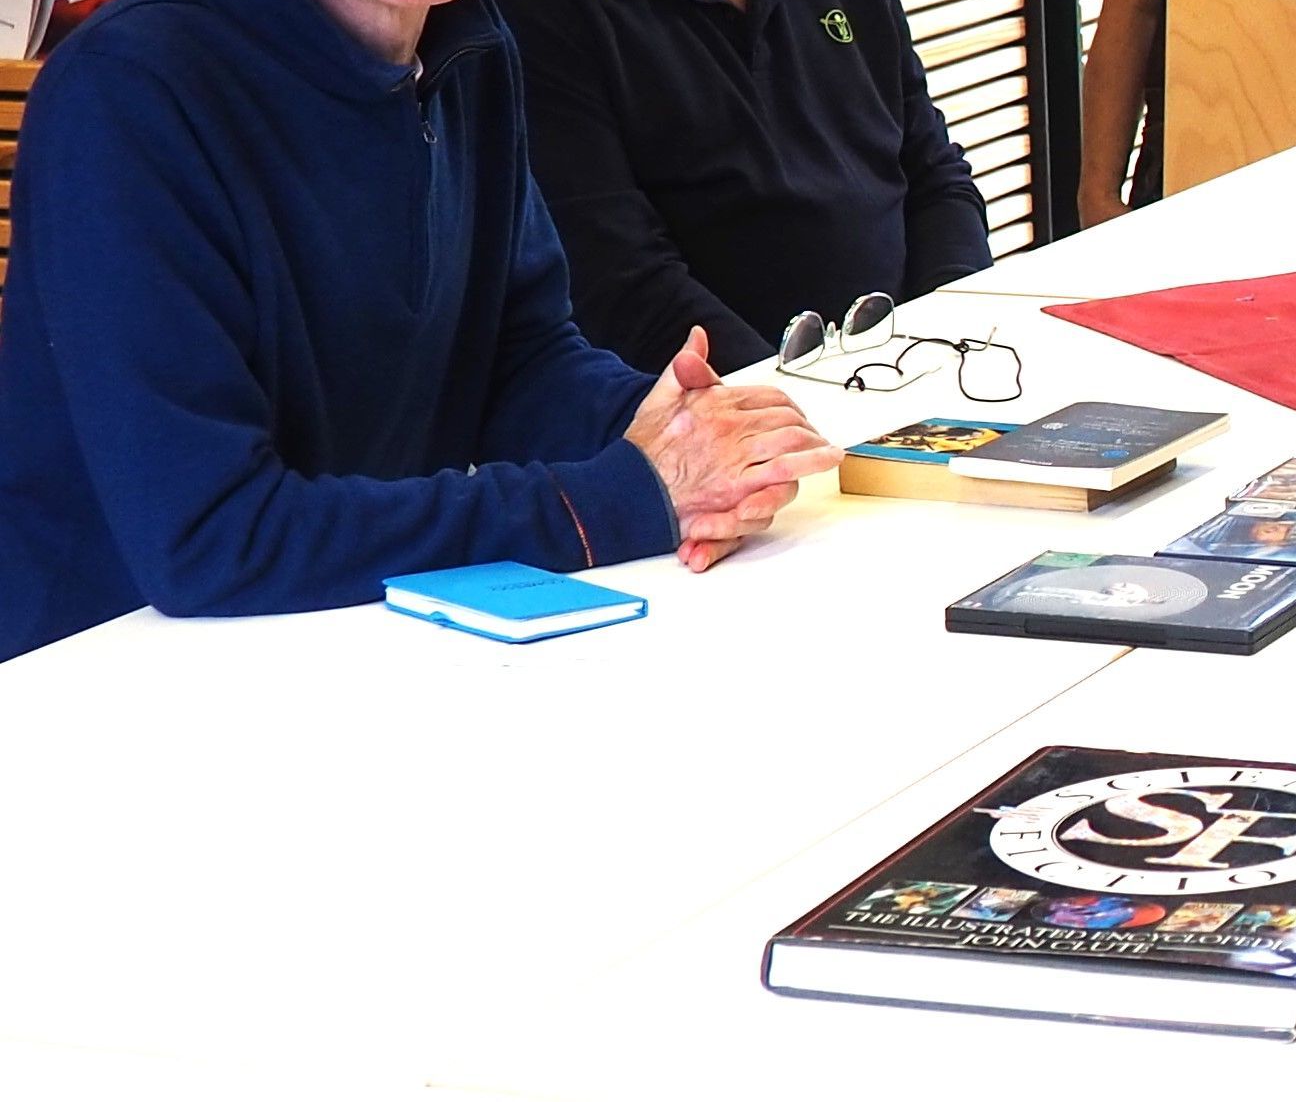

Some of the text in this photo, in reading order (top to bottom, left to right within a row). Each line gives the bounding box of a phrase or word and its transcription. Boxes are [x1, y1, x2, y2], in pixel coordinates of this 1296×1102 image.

[1216, 564, 1281, 599] MOON
[845, 910, 1285, 951] THE ILLUSTRATED ENCYCLOPEDI
[956, 933, 1154, 954] JOHN CLUTE
